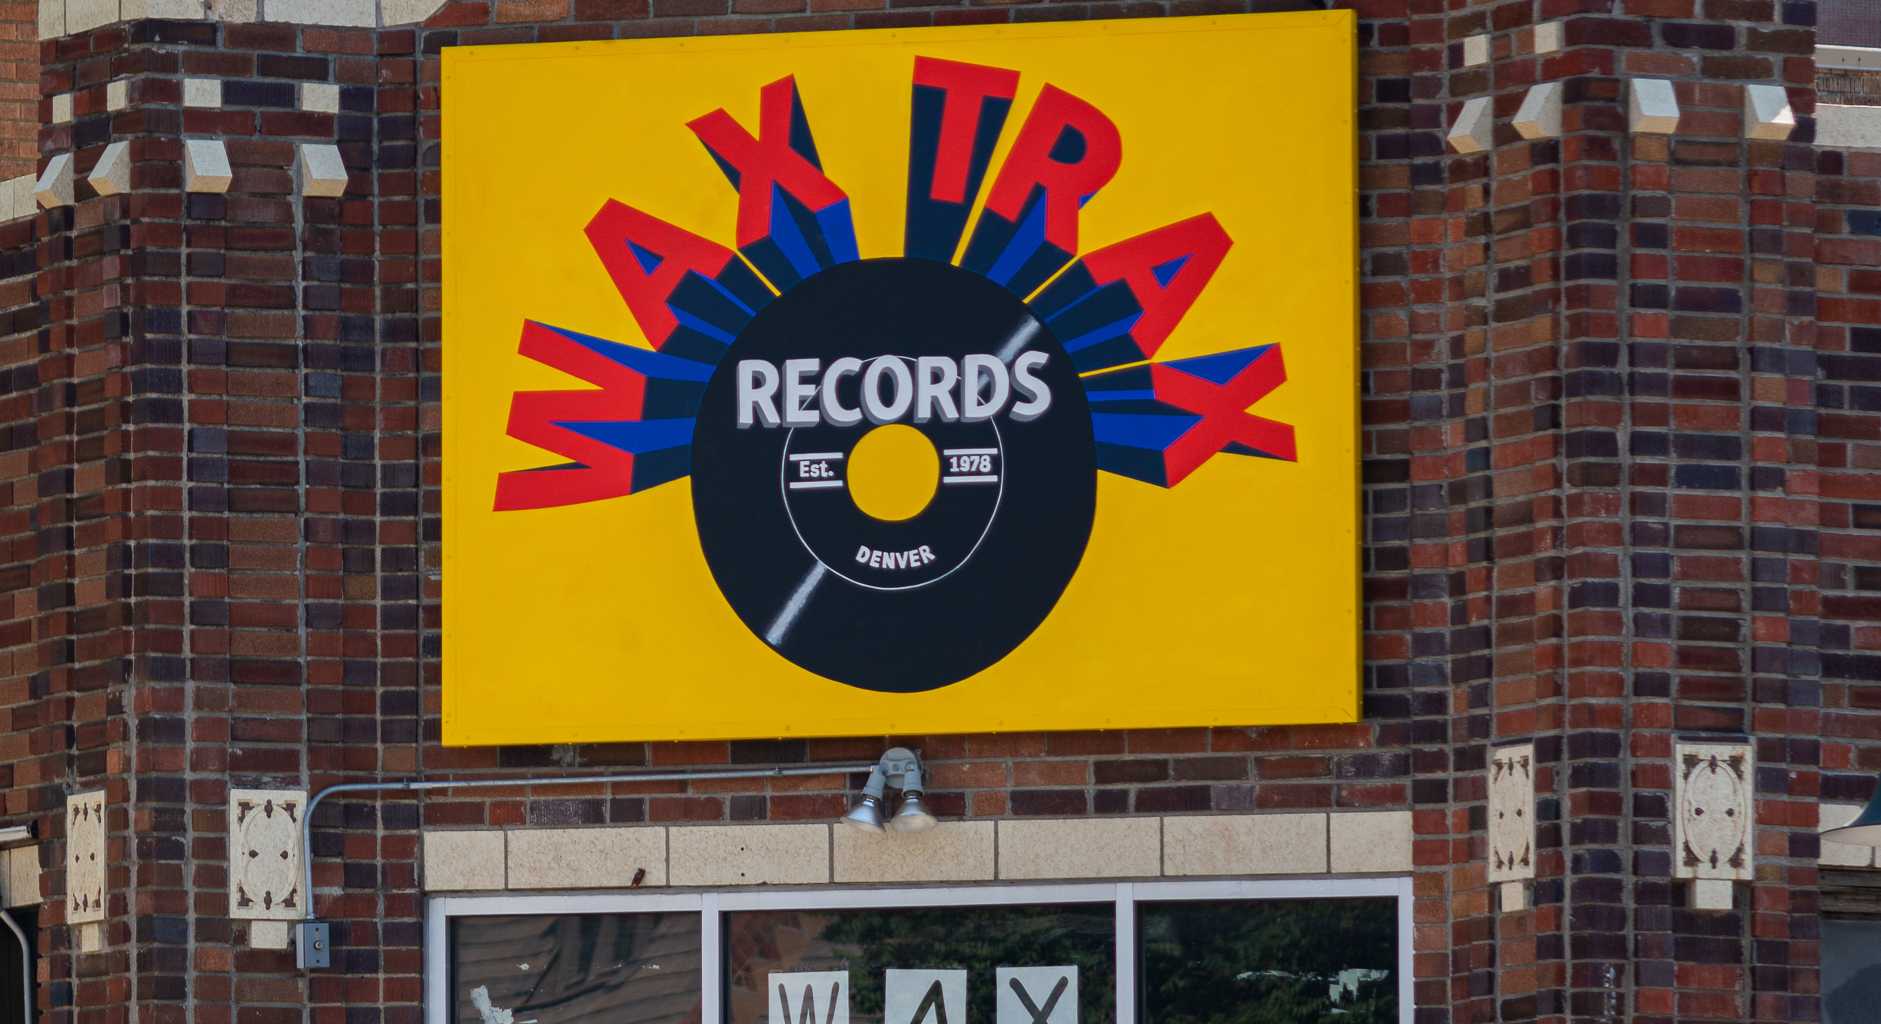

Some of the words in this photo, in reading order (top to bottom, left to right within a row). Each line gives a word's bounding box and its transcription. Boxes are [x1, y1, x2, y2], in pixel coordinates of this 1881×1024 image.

[493, 73, 852, 512] WAX
[911, 55, 1298, 489] TRAX
[736, 350, 1051, 428] RECORDS
[798, 459, 835, 480] Est.
[949, 454, 992, 475] 1978
[855, 543, 937, 571] DENVER
